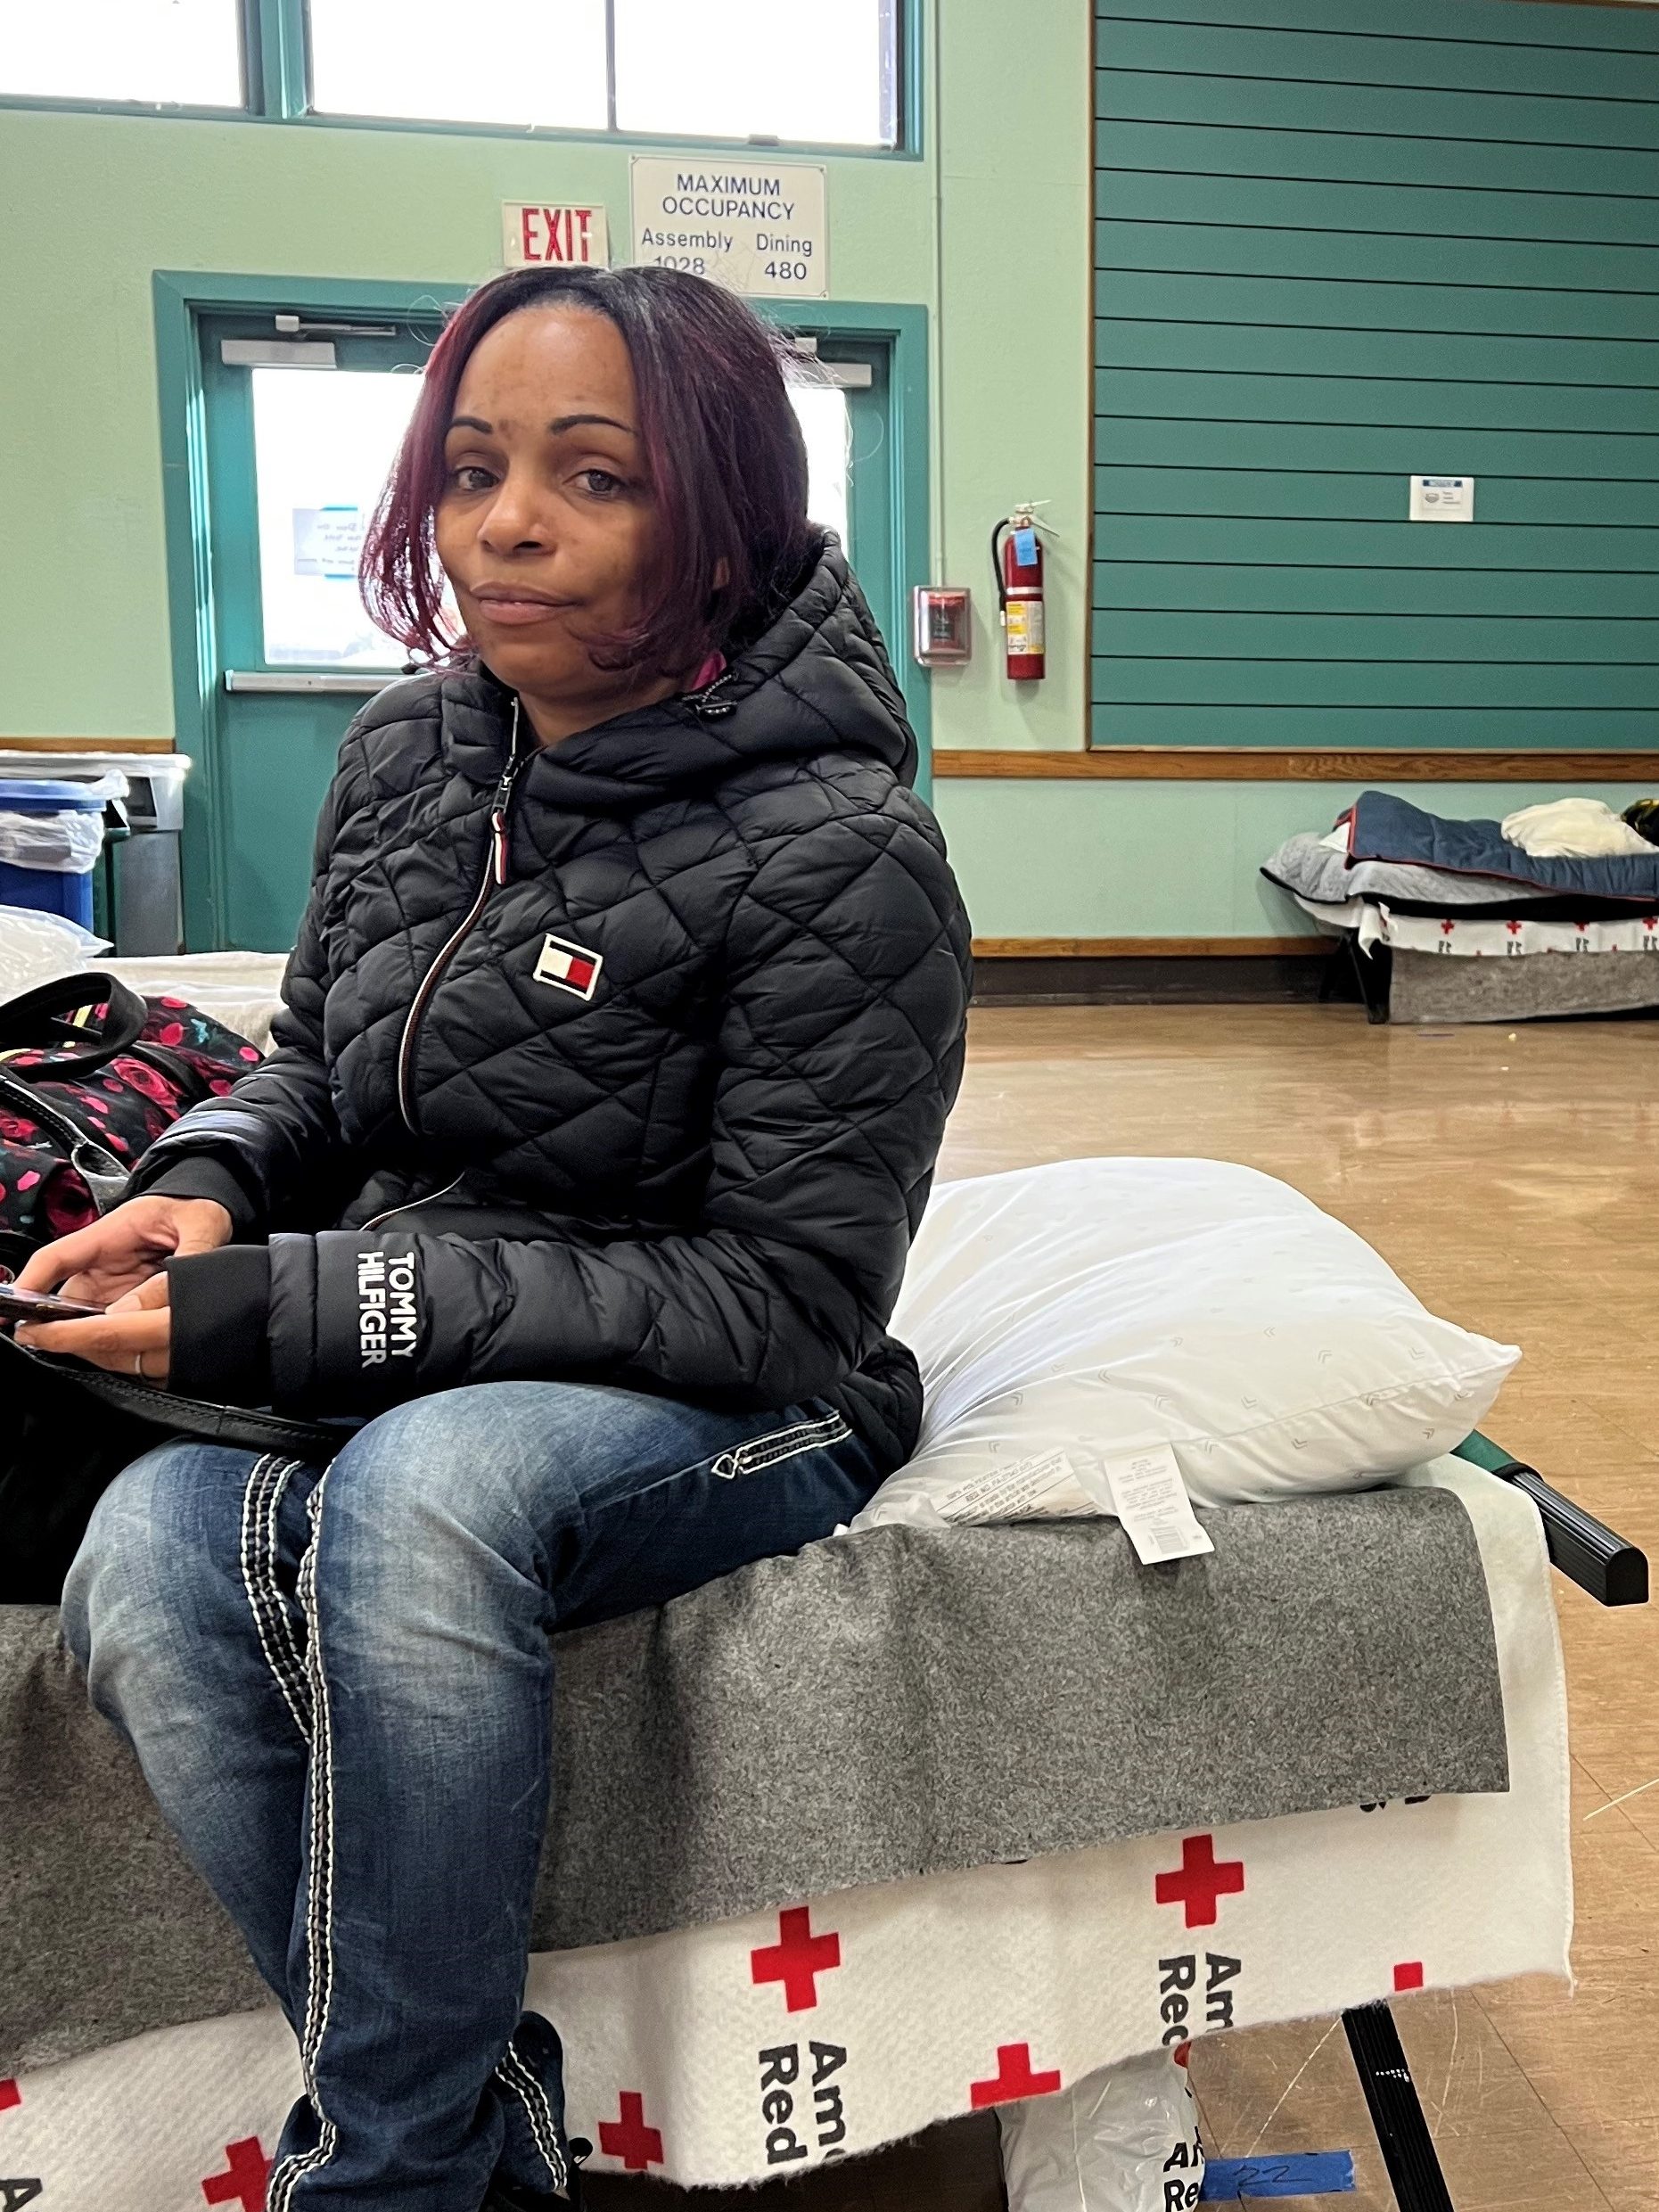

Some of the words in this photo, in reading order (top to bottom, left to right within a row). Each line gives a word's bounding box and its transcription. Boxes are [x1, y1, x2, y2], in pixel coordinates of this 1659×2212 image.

[661, 196, 795, 221] OCCUPANCY
[676, 173, 781, 196] MAXIMUM
[521, 207, 593, 263] EXIT
[641, 226, 734, 251] Assembly
[756, 232, 813, 258] Dining
[764, 261, 808, 281] 480
[357, 1251, 387, 1369] HILFIGER
[388, 1251, 417, 1358] TOMMY
[759, 2043, 809, 2165] Red
[809, 2040, 848, 2161] Am
